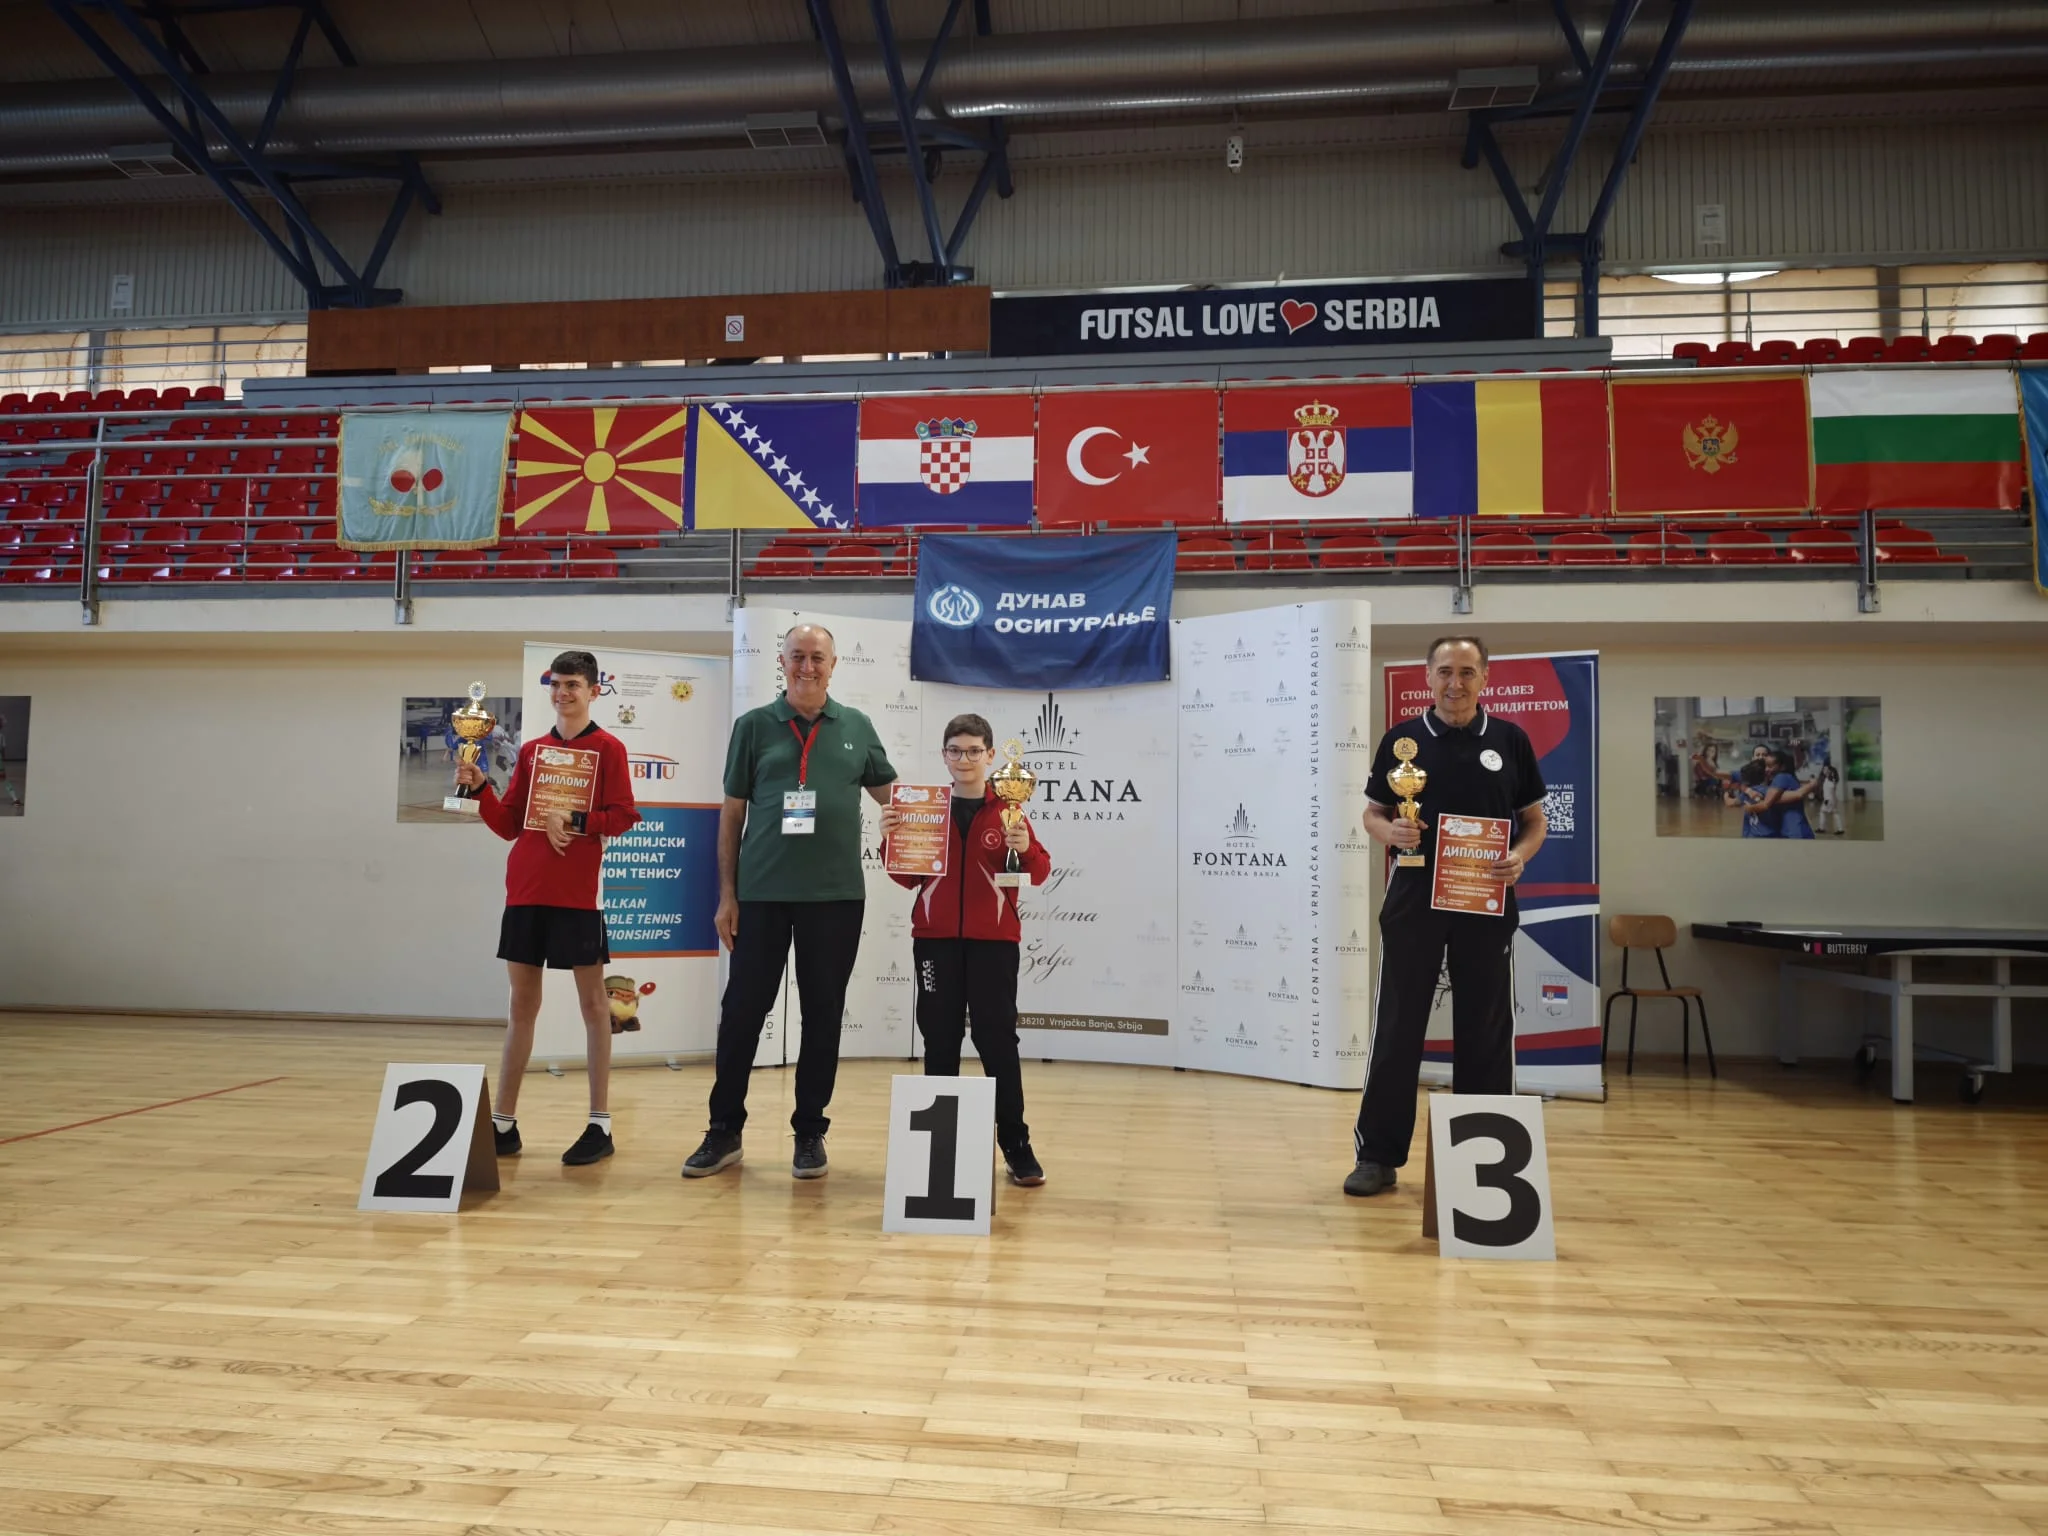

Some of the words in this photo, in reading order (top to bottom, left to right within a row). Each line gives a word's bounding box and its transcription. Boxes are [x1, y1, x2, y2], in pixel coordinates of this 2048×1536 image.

[1080, 306, 1193, 340] FUTSAL
[1202, 302, 1276, 336] LOVE
[1324, 297, 1441, 331] SERBIA
[996, 592, 1086, 611] ДУНАВ
[994, 606, 1157, 634] ОСИГУРАЊЕ
[1311, 627, 1319, 696] PARADISE
[1497, 685, 1535, 696] САВЕЗ
[1481, 700, 1569, 714] АЛИДИТЕТОМ
[1311, 703, 1319, 775] WELLNESS
[1023, 762, 1078, 770] HOTEL
[537, 773, 589, 788] ДИПЛОМУ
[1028, 779, 1142, 802] TANA
[897, 813, 945, 824] ИПЛОМУ
[1030, 810, 1062, 820] ČKA
[1073, 812, 1125, 821] BANJA
[1311, 795, 1320, 838] BANJA
[630, 821, 664, 832] НСКИ
[602, 852, 666, 863] МПИОНАТ
[1193, 852, 1287, 867] FONTANA
[1442, 845, 1502, 861] ДИПЛОМУ
[630, 868, 682, 879] ТЕНИСУ
[1042, 862, 1084, 895] oja
[1309, 845, 1320, 917] VRNJAČKA
[604, 898, 647, 909] ALKAN
[637, 914, 683, 924] TENNIS
[607, 929, 672, 940] PIONSHIPS
[1827, 944, 1868, 954] BUTTERFLY
[1311, 936, 1320, 1004] FONTANA
[766, 1013, 774, 1040] HOT
[1021, 1017, 1045, 1026] 36210
[1050, 1017, 1087, 1029] Vrnjačka
[1088, 1019, 1116, 1030] Banja,
[1117, 1020, 1143, 1031] Srbija
[1312, 1011, 1320, 1058] HOTEL
[373, 1079, 464, 1198] 2
[903, 1095, 976, 1221] 1
[1449, 1112, 1542, 1247] 3
